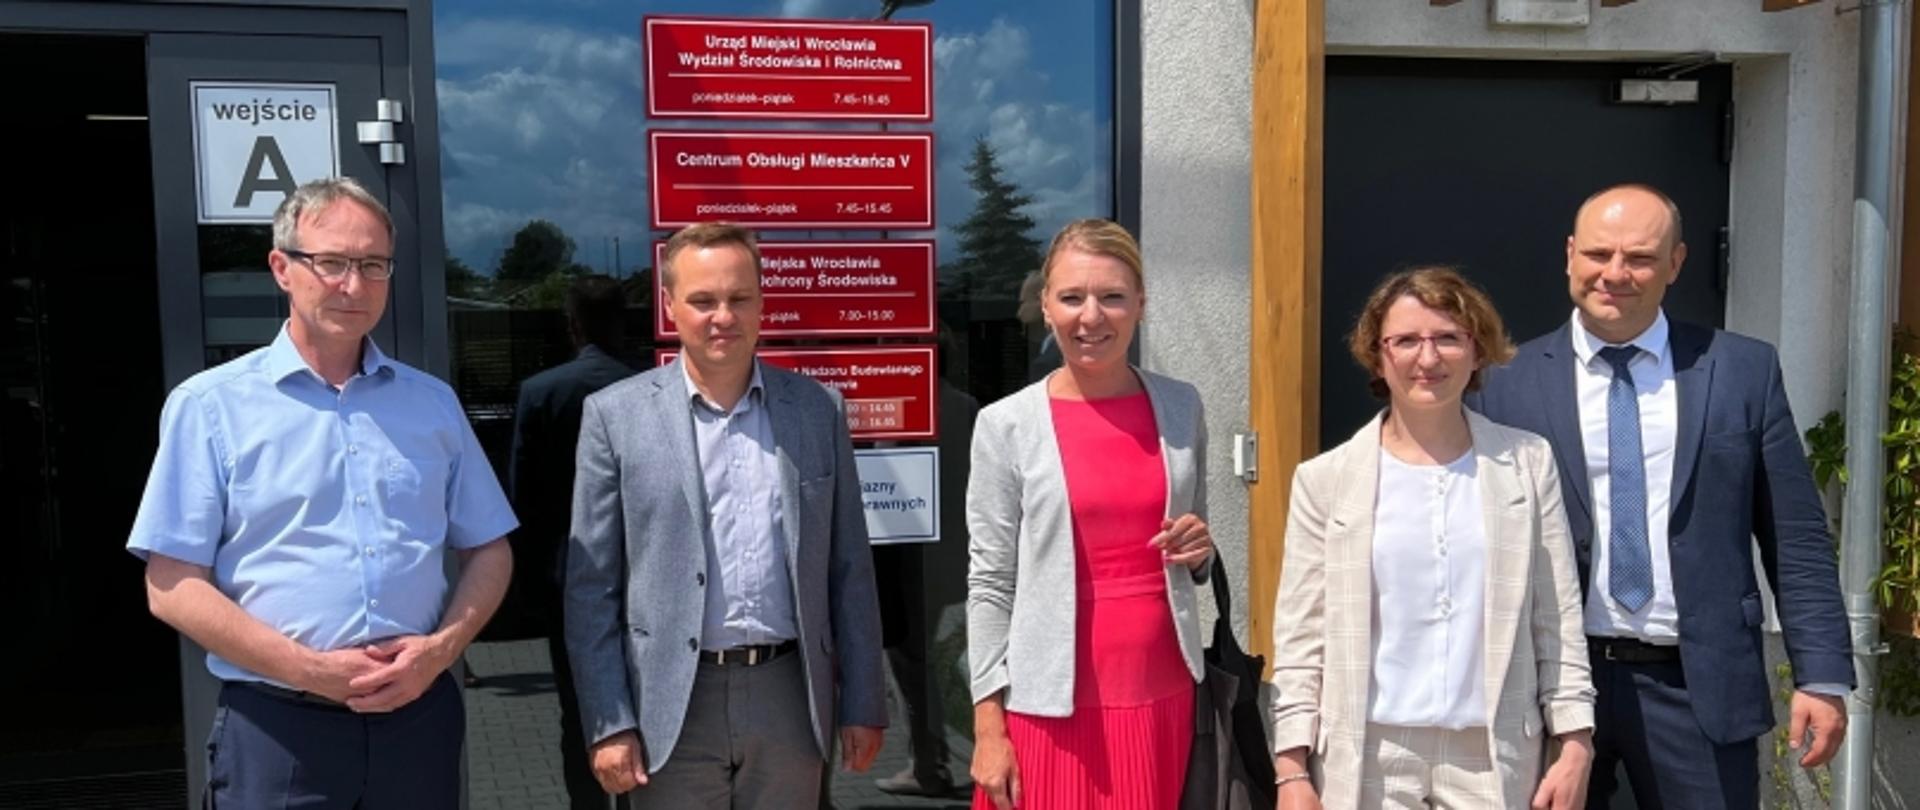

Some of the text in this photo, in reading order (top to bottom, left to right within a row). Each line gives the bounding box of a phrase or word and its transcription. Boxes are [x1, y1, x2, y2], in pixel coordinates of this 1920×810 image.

[705, 33, 876, 53] Urząd Miejski Wrocławia
[678, 52, 734, 69] Wydział
[739, 51, 821, 69] Środowiska
[834, 56, 902, 70] Rolnictwa
[212, 98, 317, 126] wejście
[676, 152, 910, 170] Centrum Obsługi Mieszkańca V
[233, 135, 298, 208] A
[811, 256, 880, 269] Wrocławia
[817, 272, 897, 287] Środowiska
[851, 364, 923, 376] Budowlanego
